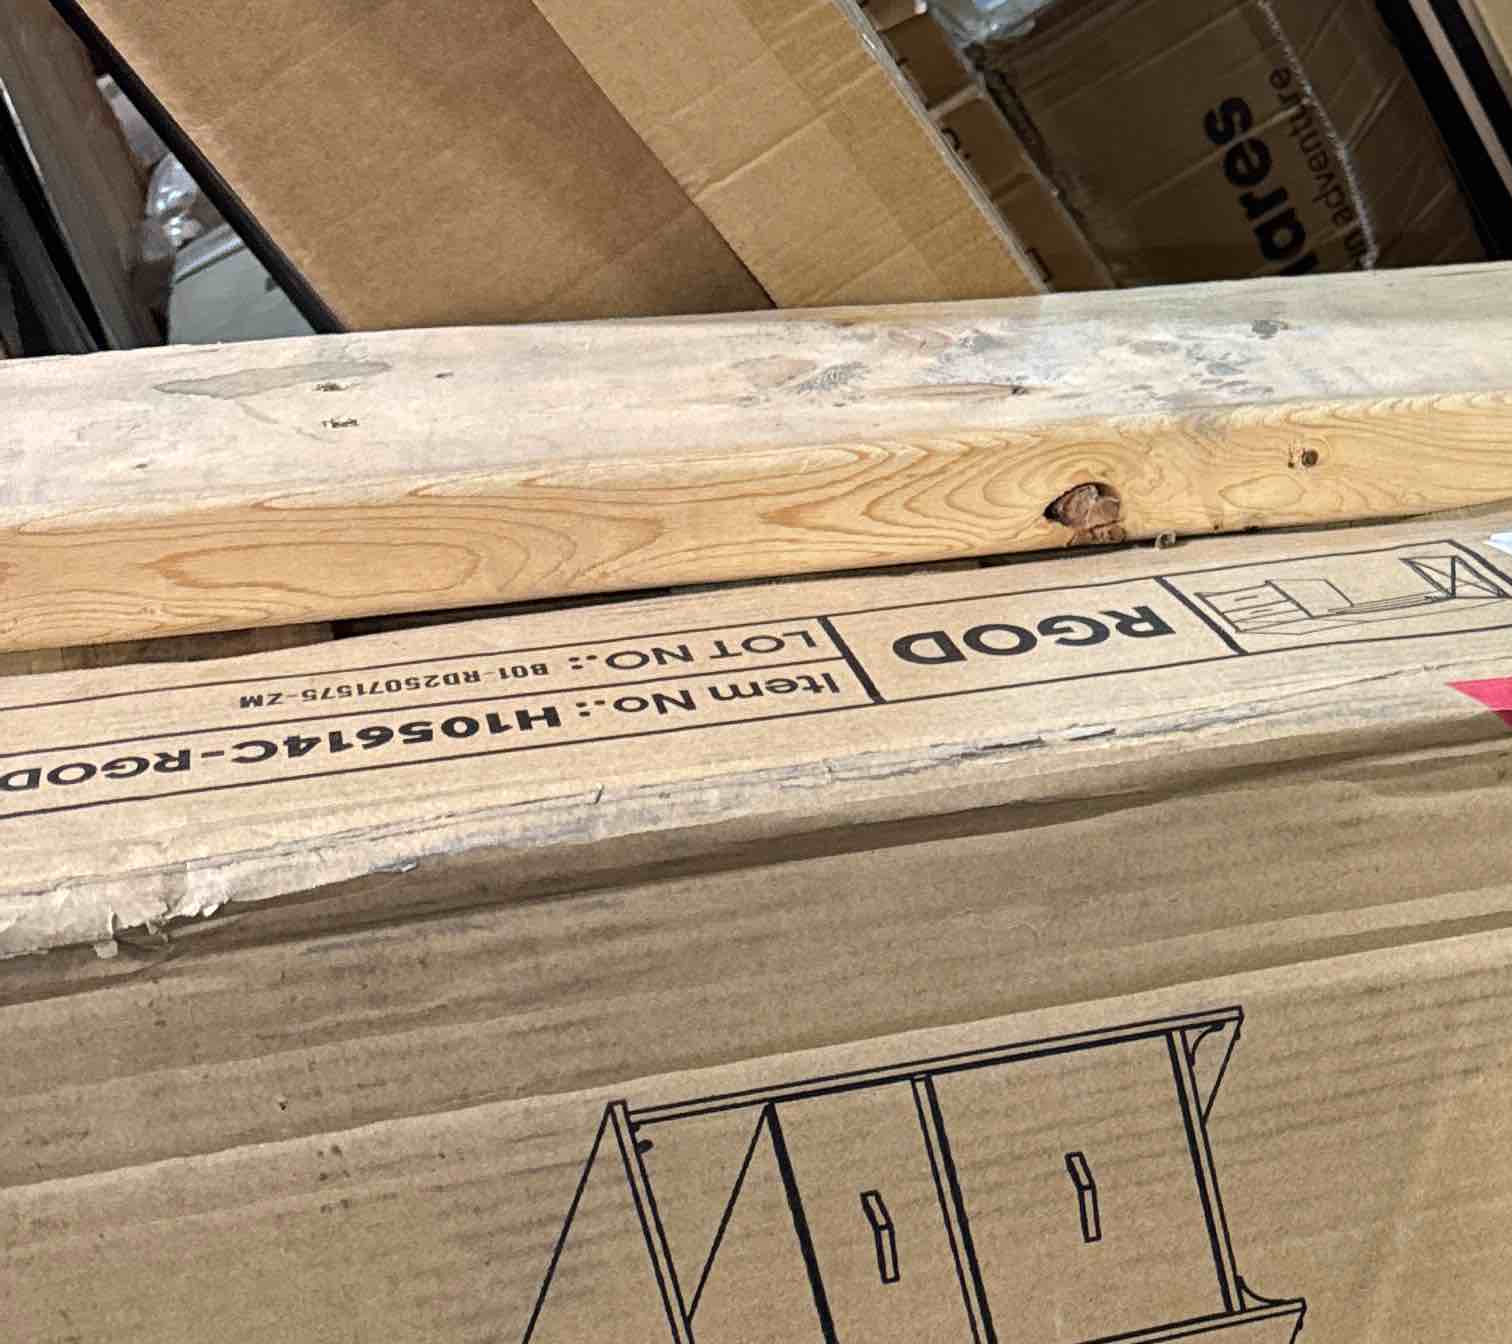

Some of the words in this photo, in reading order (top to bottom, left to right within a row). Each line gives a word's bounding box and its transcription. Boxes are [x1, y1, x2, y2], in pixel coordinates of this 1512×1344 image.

[1269, 67, 1357, 226] adventure
[709, 629, 818, 659] LOT
[892, 606, 1176, 665] RGOD
[568, 644, 695, 671] NO.:
[707, 672, 841, 702] Item
[574, 690, 697, 717] No.:
[0, 706, 562, 793] H105614C-RGOD
